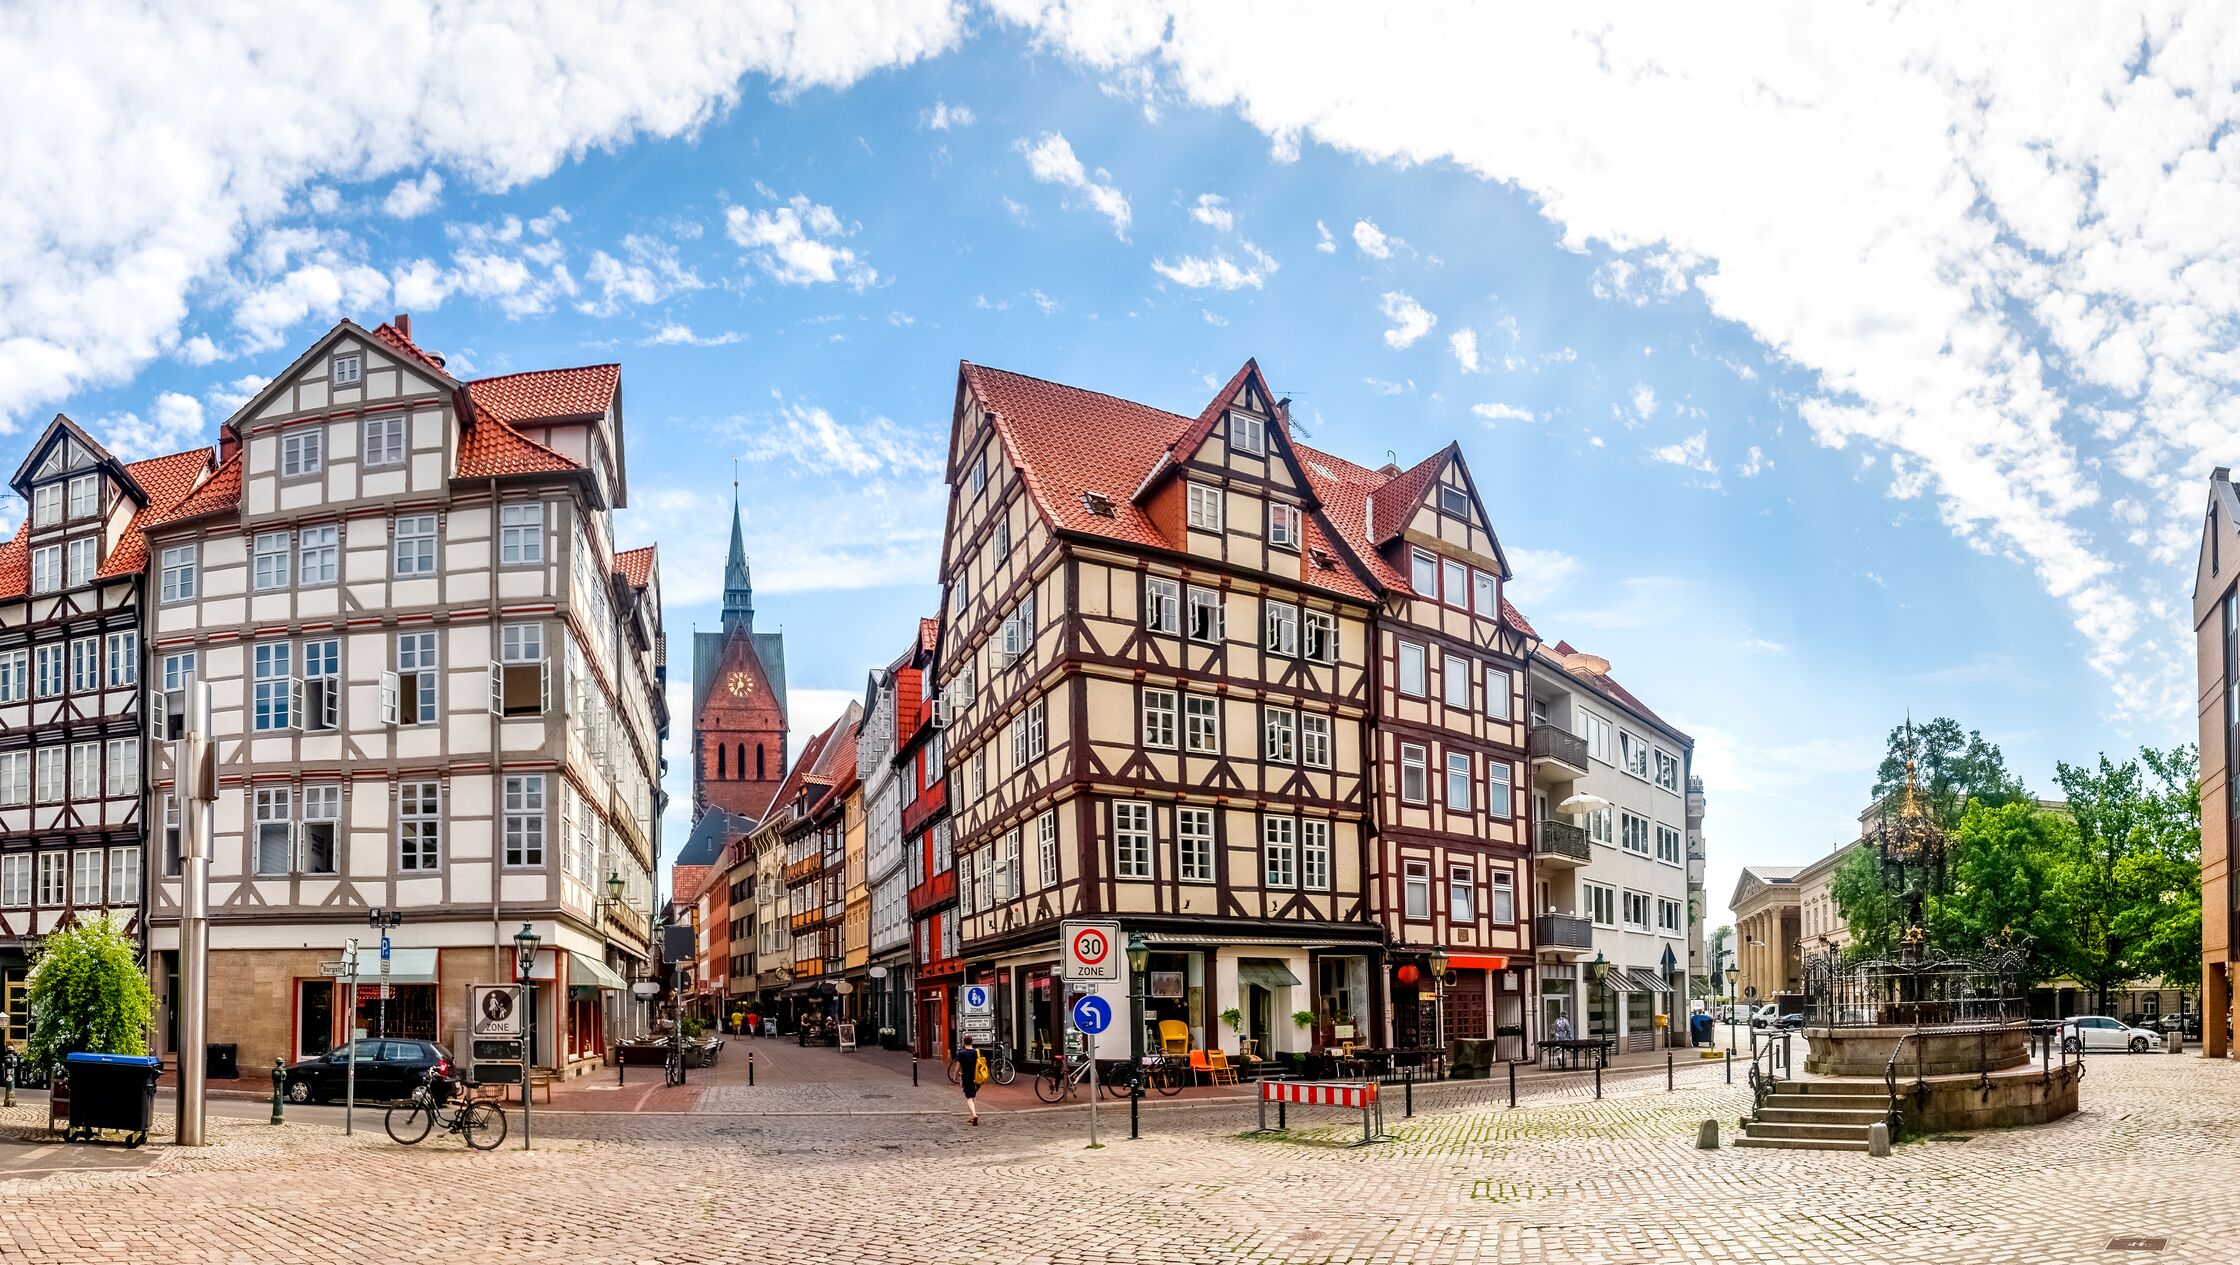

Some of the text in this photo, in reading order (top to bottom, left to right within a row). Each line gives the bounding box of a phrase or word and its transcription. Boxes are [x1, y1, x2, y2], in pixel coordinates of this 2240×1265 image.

[382, 940, 388, 956] P
[1081, 939, 1101, 955] 30
[1078, 967, 1104, 976] ZONE
[486, 1023, 509, 1032] ZONE
